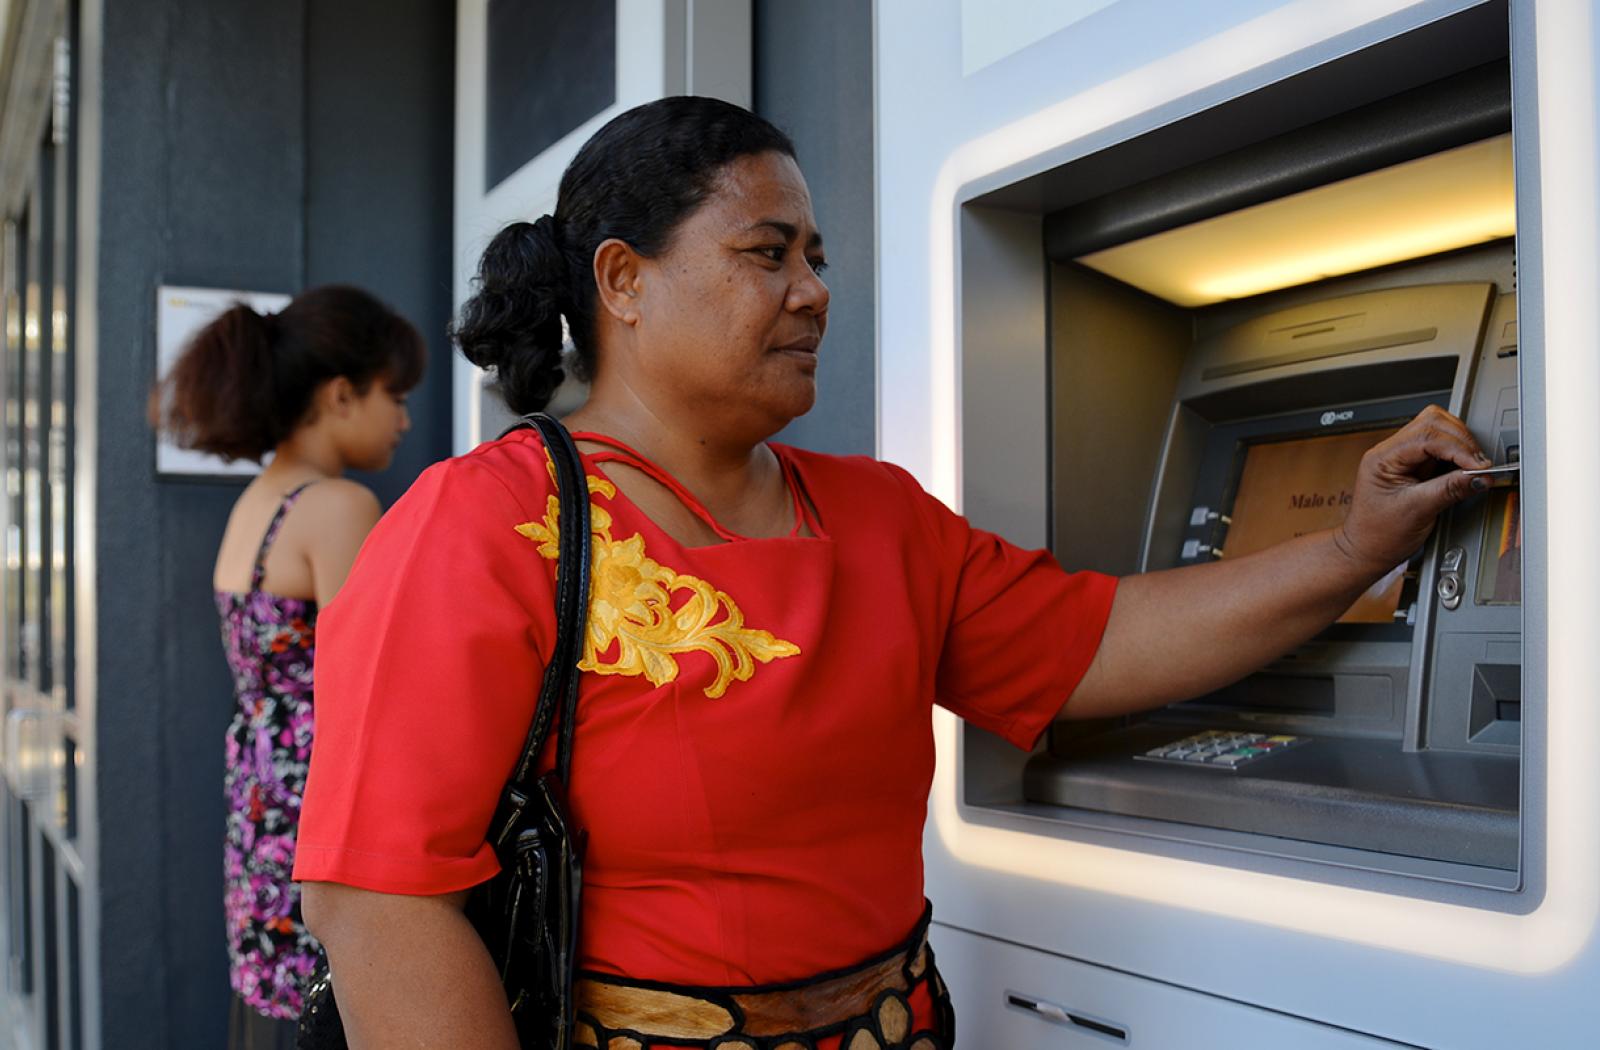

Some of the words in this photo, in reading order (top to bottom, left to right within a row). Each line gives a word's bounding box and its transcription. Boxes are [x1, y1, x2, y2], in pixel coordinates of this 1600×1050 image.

[1288, 493, 1325, 509] Malo
[1327, 495, 1336, 507] e
[1338, 490, 1353, 506] le
